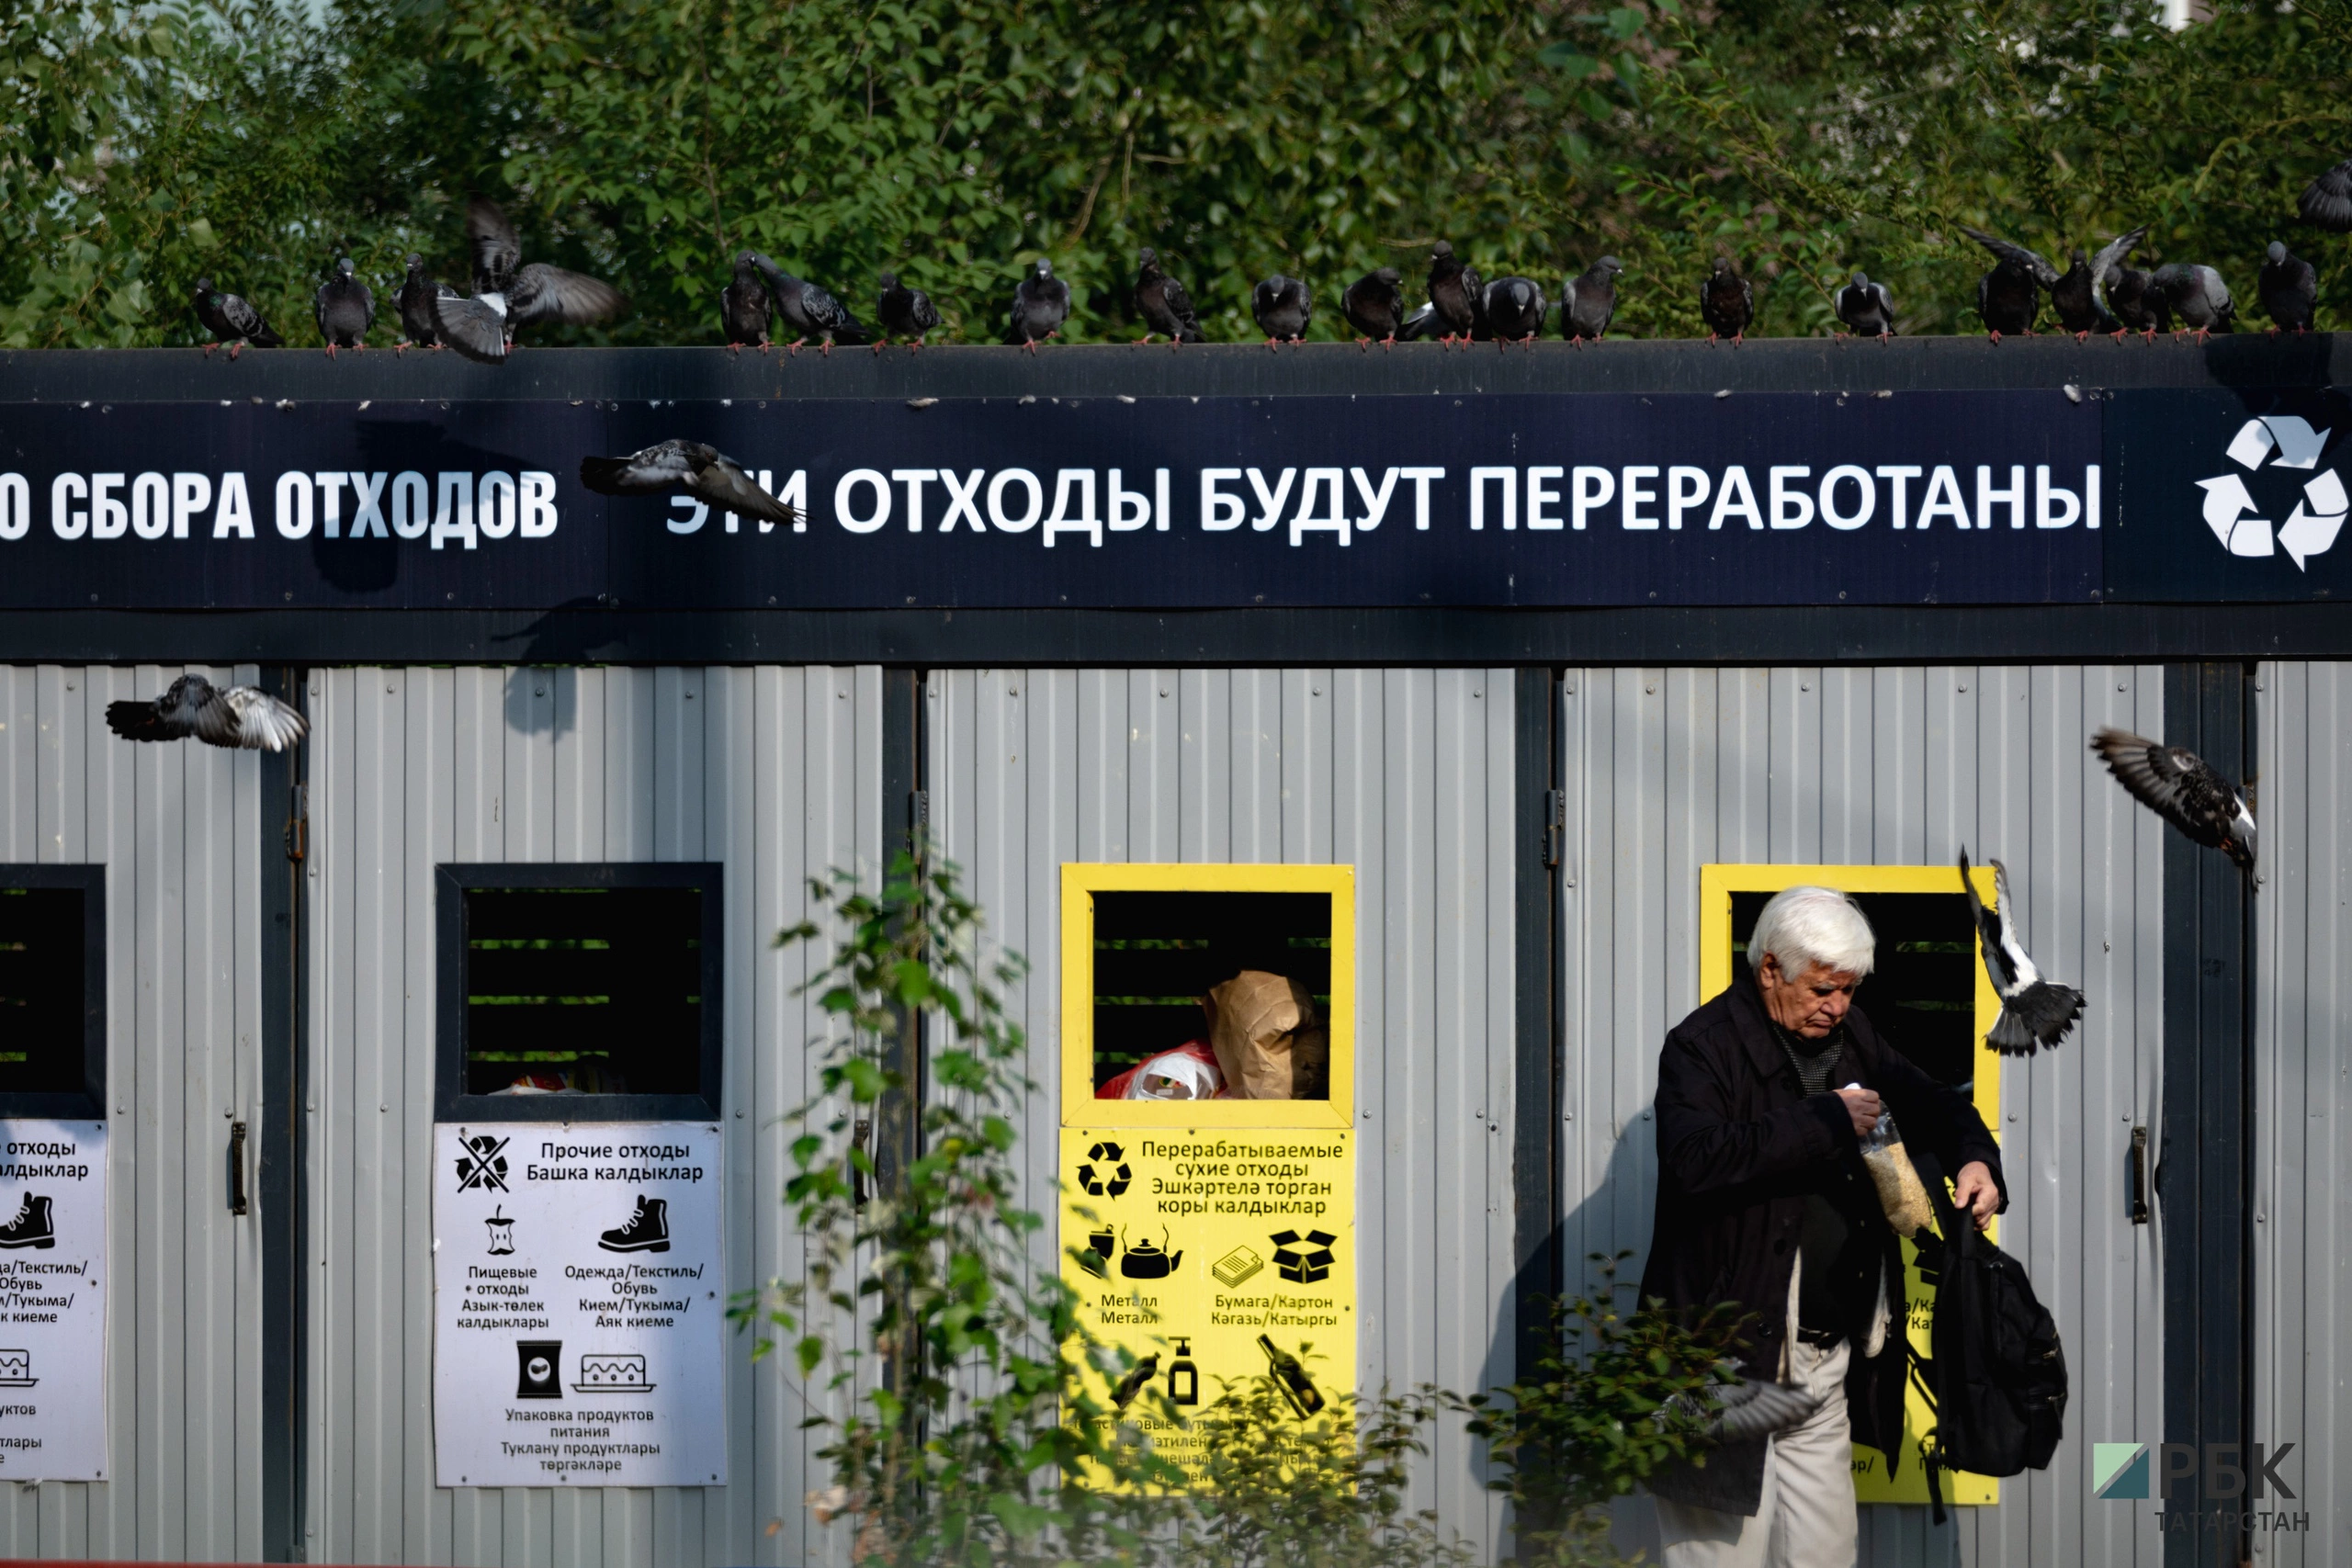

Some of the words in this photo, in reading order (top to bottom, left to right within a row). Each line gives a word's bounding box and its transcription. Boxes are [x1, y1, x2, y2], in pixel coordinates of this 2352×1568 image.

[0, 471, 30, 541] О
[51, 471, 256, 541] СБОРА
[276, 469, 559, 550] ОТХОДОВ
[833, 468, 1170, 548] ОТХОДЫ
[1200, 467, 1445, 547] БУДУТ
[1470, 463, 2102, 531] ПЕРЕРАБОТАНЫ
[6, 1142, 76, 1159] отходы
[541, 1142, 615, 1161] Прочие
[618, 1144, 690, 1160] отходы
[1142, 1141, 1343, 1160] Перерабатываемые
[526, 1165, 589, 1181] Башка
[595, 1166, 703, 1183] калдыклар
[1176, 1163, 1229, 1179] сухие
[1236, 1163, 1308, 1179] отходы
[1152, 1179, 1261, 1199] Эшкәртелә
[1266, 1181, 1331, 1199] торган
[1158, 1200, 1208, 1217] коры
[1215, 1200, 1327, 1218] калдыклар
[469, 1266, 537, 1280] Пищевые
[564, 1263, 704, 1280] Одежда/Текстиль/
[0, 1276, 42, 1293] Обувь
[477, 1284, 529, 1295] отходы
[612, 1281, 658, 1297] Обувь
[462, 1299, 544, 1312] Азык-төлек
[579, 1296, 690, 1314] Кием/Тукыма/
[1216, 1293, 1333, 1311] Бумага/Картон
[13, 1313, 58, 1323] киеме
[457, 1317, 549, 1330] калдыклары
[595, 1316, 622, 1328] Аяк
[627, 1317, 674, 1328] киеме
[1102, 1311, 1158, 1324] Металл
[1211, 1311, 1337, 1328] Кәгазь/Катыргы
[505, 1408, 572, 1421] Упаковка
[577, 1410, 654, 1424] продуктов
[550, 1427, 609, 1438] питания
[501, 1441, 560, 1457] Туклану
[563, 1443, 660, 1458] продуктлары
[540, 1461, 622, 1473] төргәкләре
